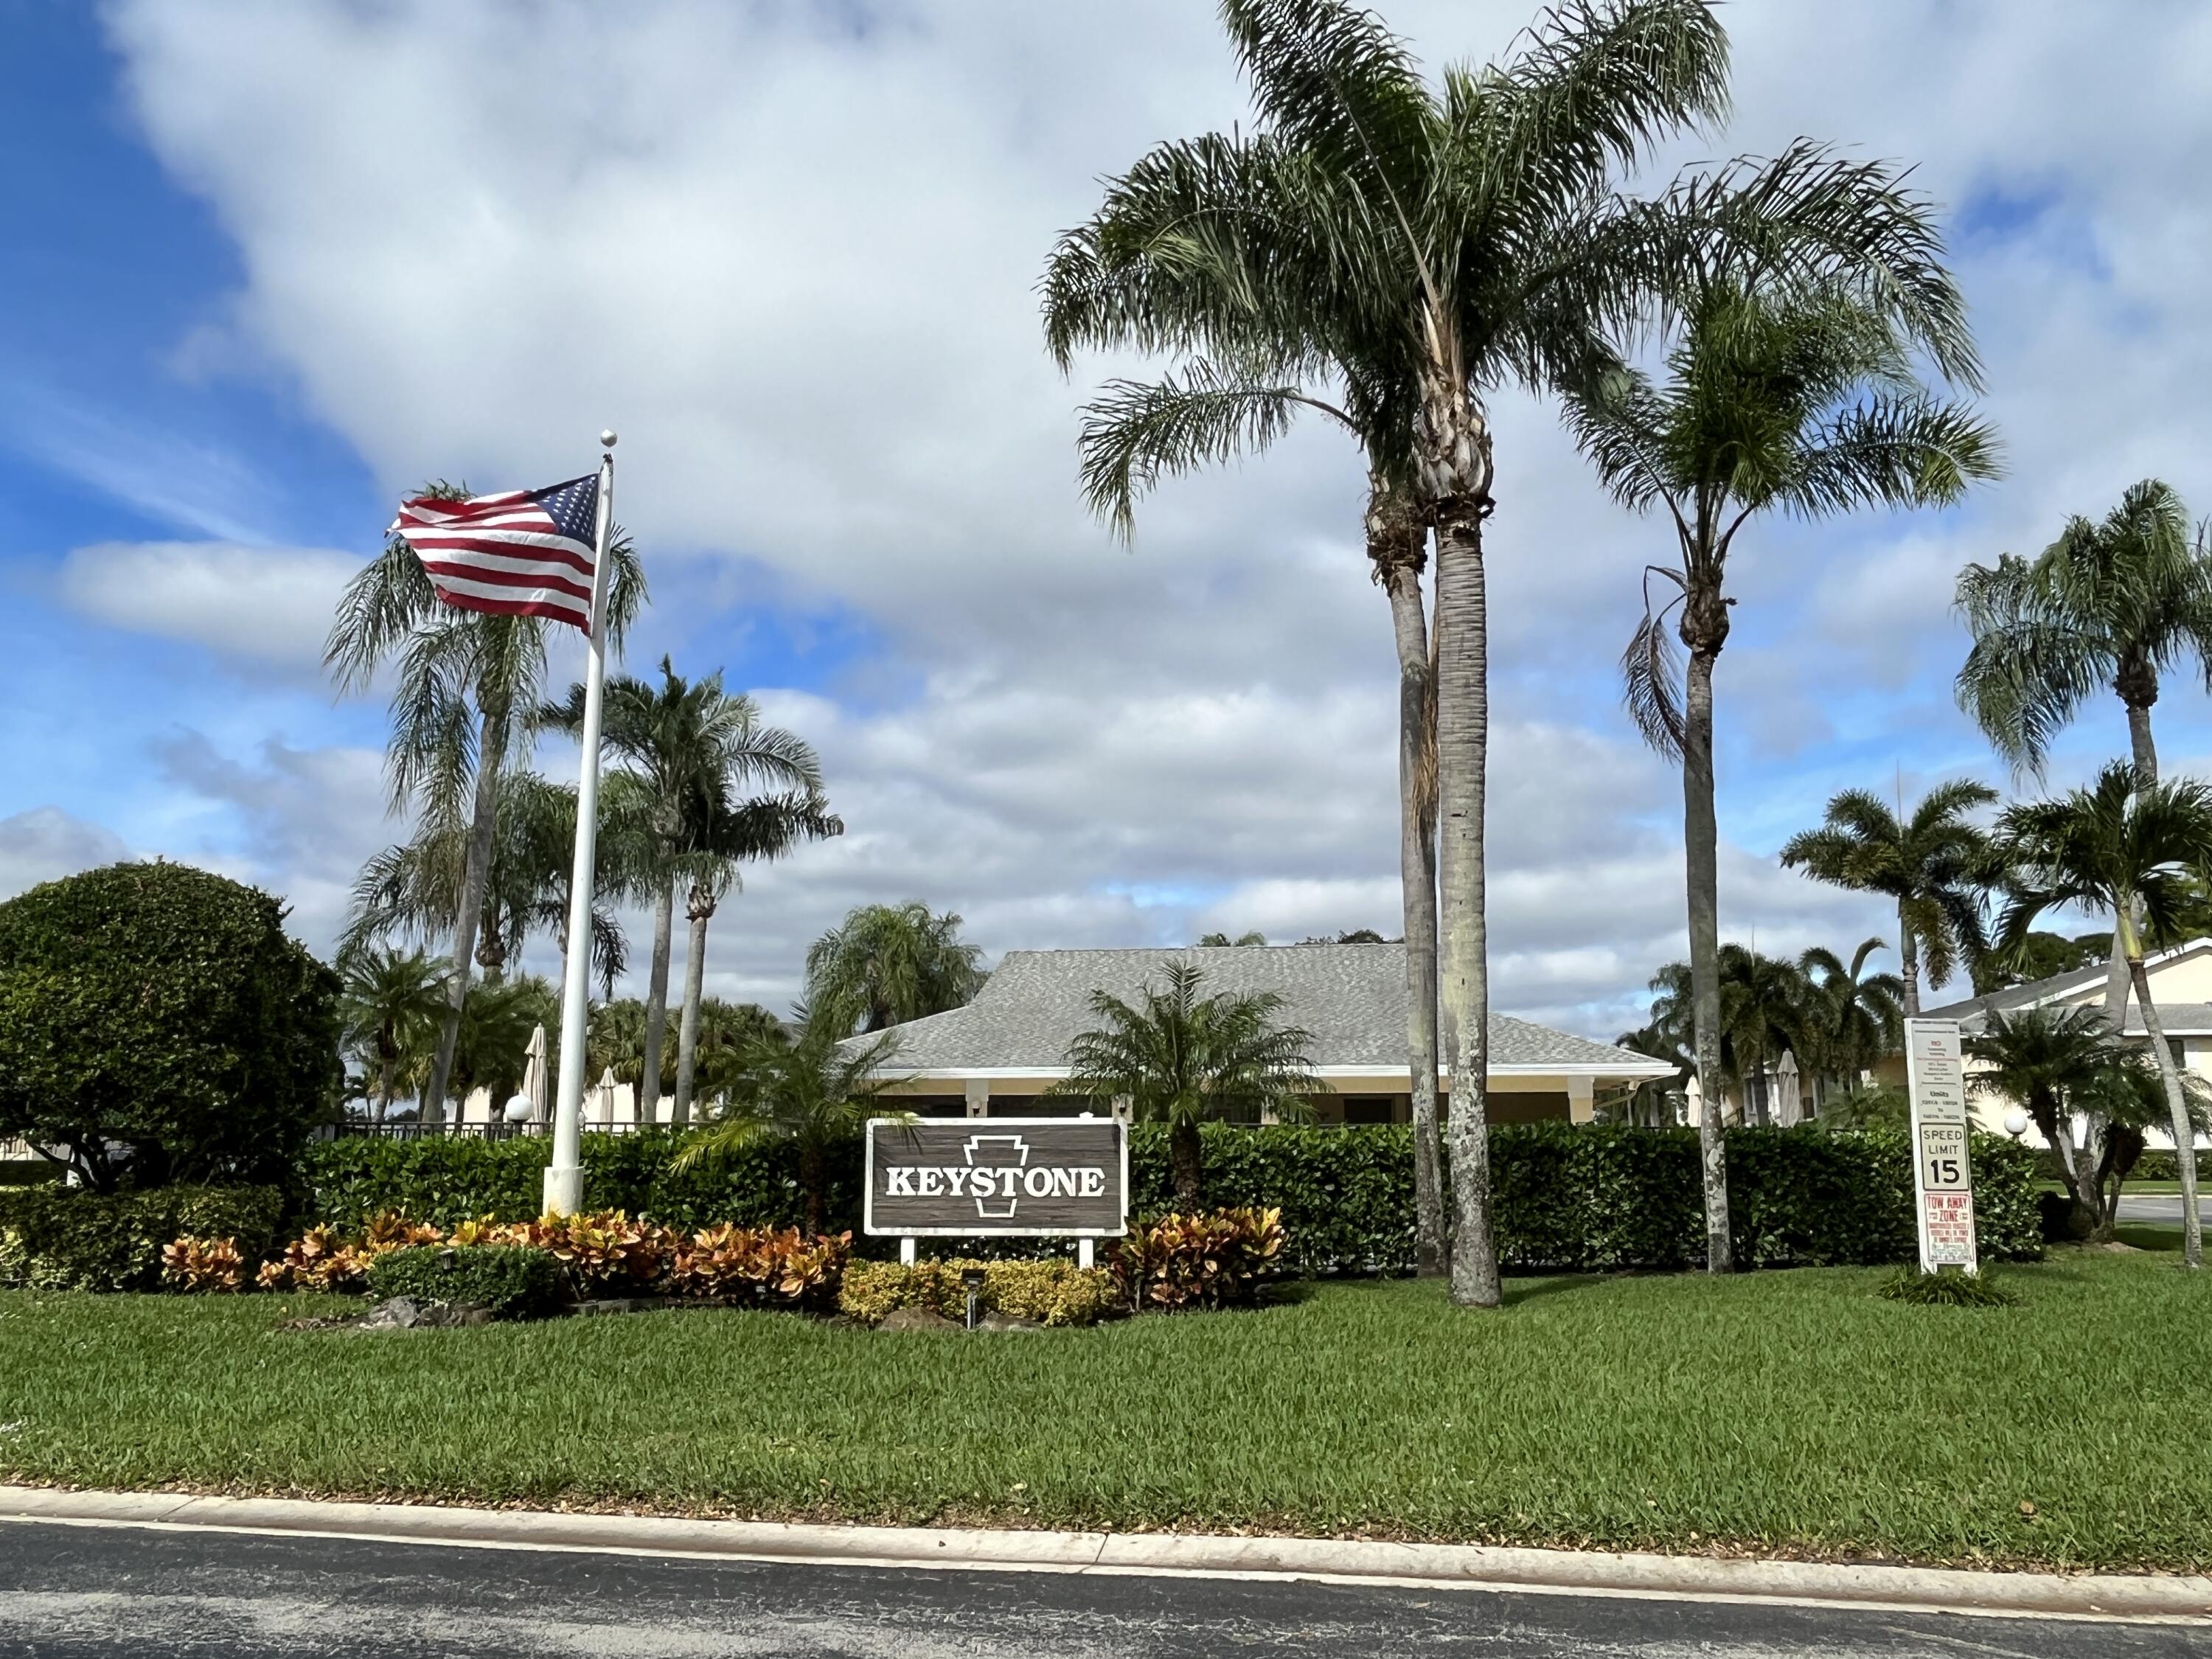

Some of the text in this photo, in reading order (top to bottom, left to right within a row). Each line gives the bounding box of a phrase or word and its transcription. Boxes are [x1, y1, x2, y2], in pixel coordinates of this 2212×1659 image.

[1923, 1130, 1963, 1141] SPEED
[1928, 1144, 1959, 1155] LIMIT
[1930, 1159, 1960, 1183] 15
[886, 1166, 1105, 1197] KEYSTONE
[1927, 1196, 1967, 1209] TOW AWAY
[1939, 1210, 1958, 1222] ZONE
